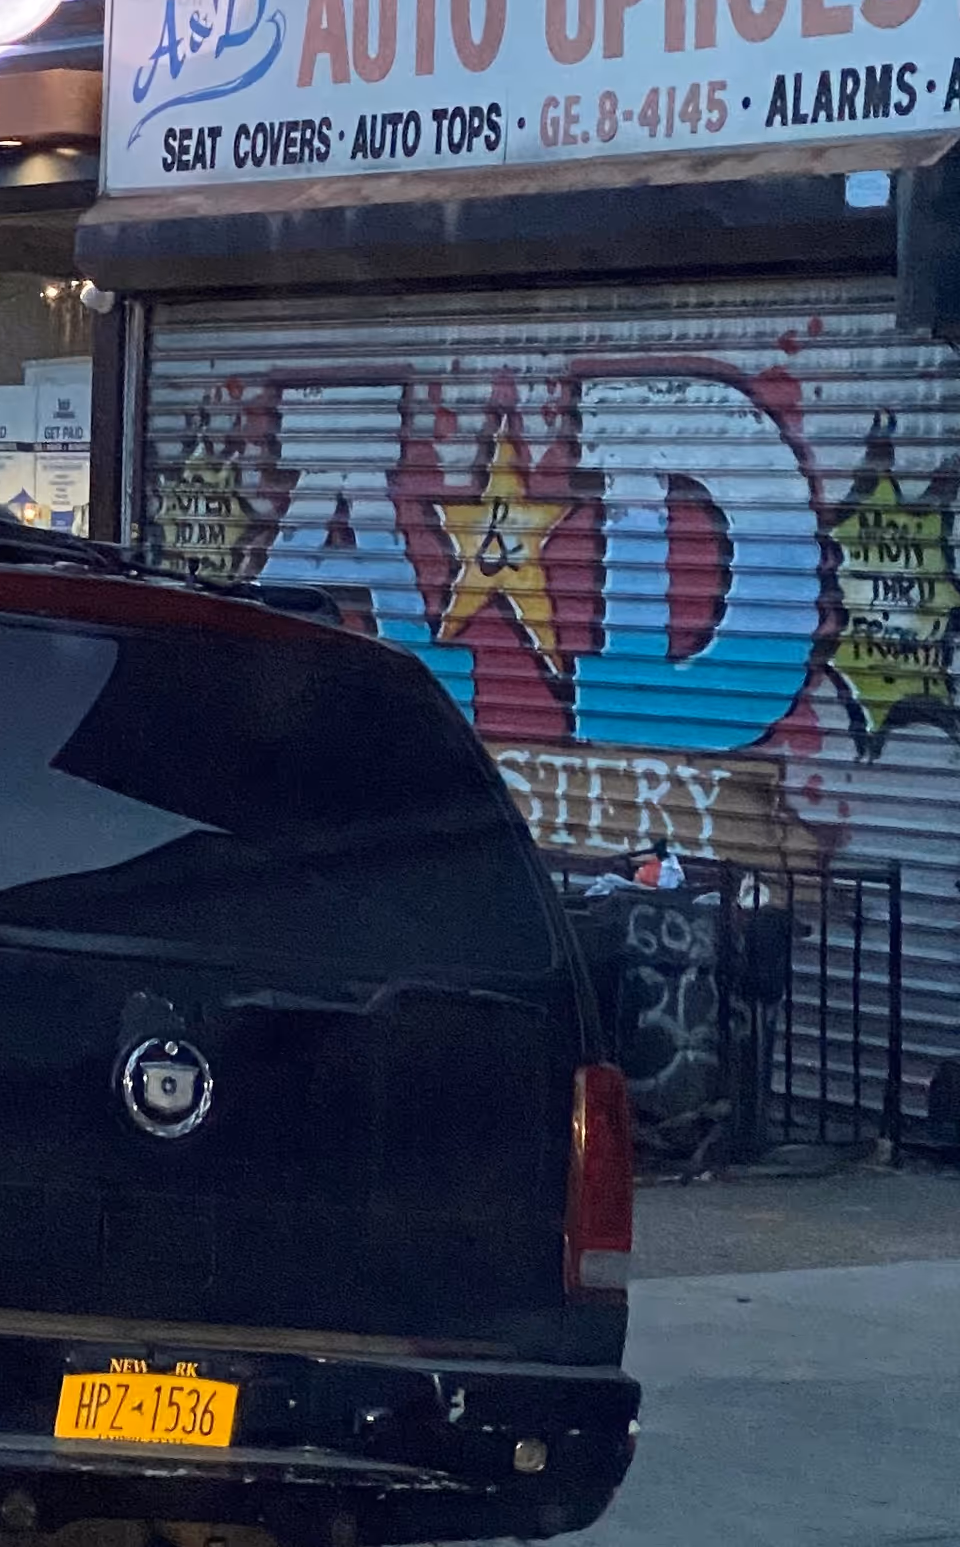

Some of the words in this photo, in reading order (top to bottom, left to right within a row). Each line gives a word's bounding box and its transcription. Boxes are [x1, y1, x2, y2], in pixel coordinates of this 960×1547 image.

[161, 124, 223, 173] SEAT
[233, 116, 332, 168] COVERS
[349, 109, 422, 161] AUTO
[431, 101, 502, 154] TOPS
[764, 61, 918, 127] ALARMS
[44, 426, 60, 440] GET
[62, 426, 84, 440] PAID
[150, 1384, 218, 1438] 1536
